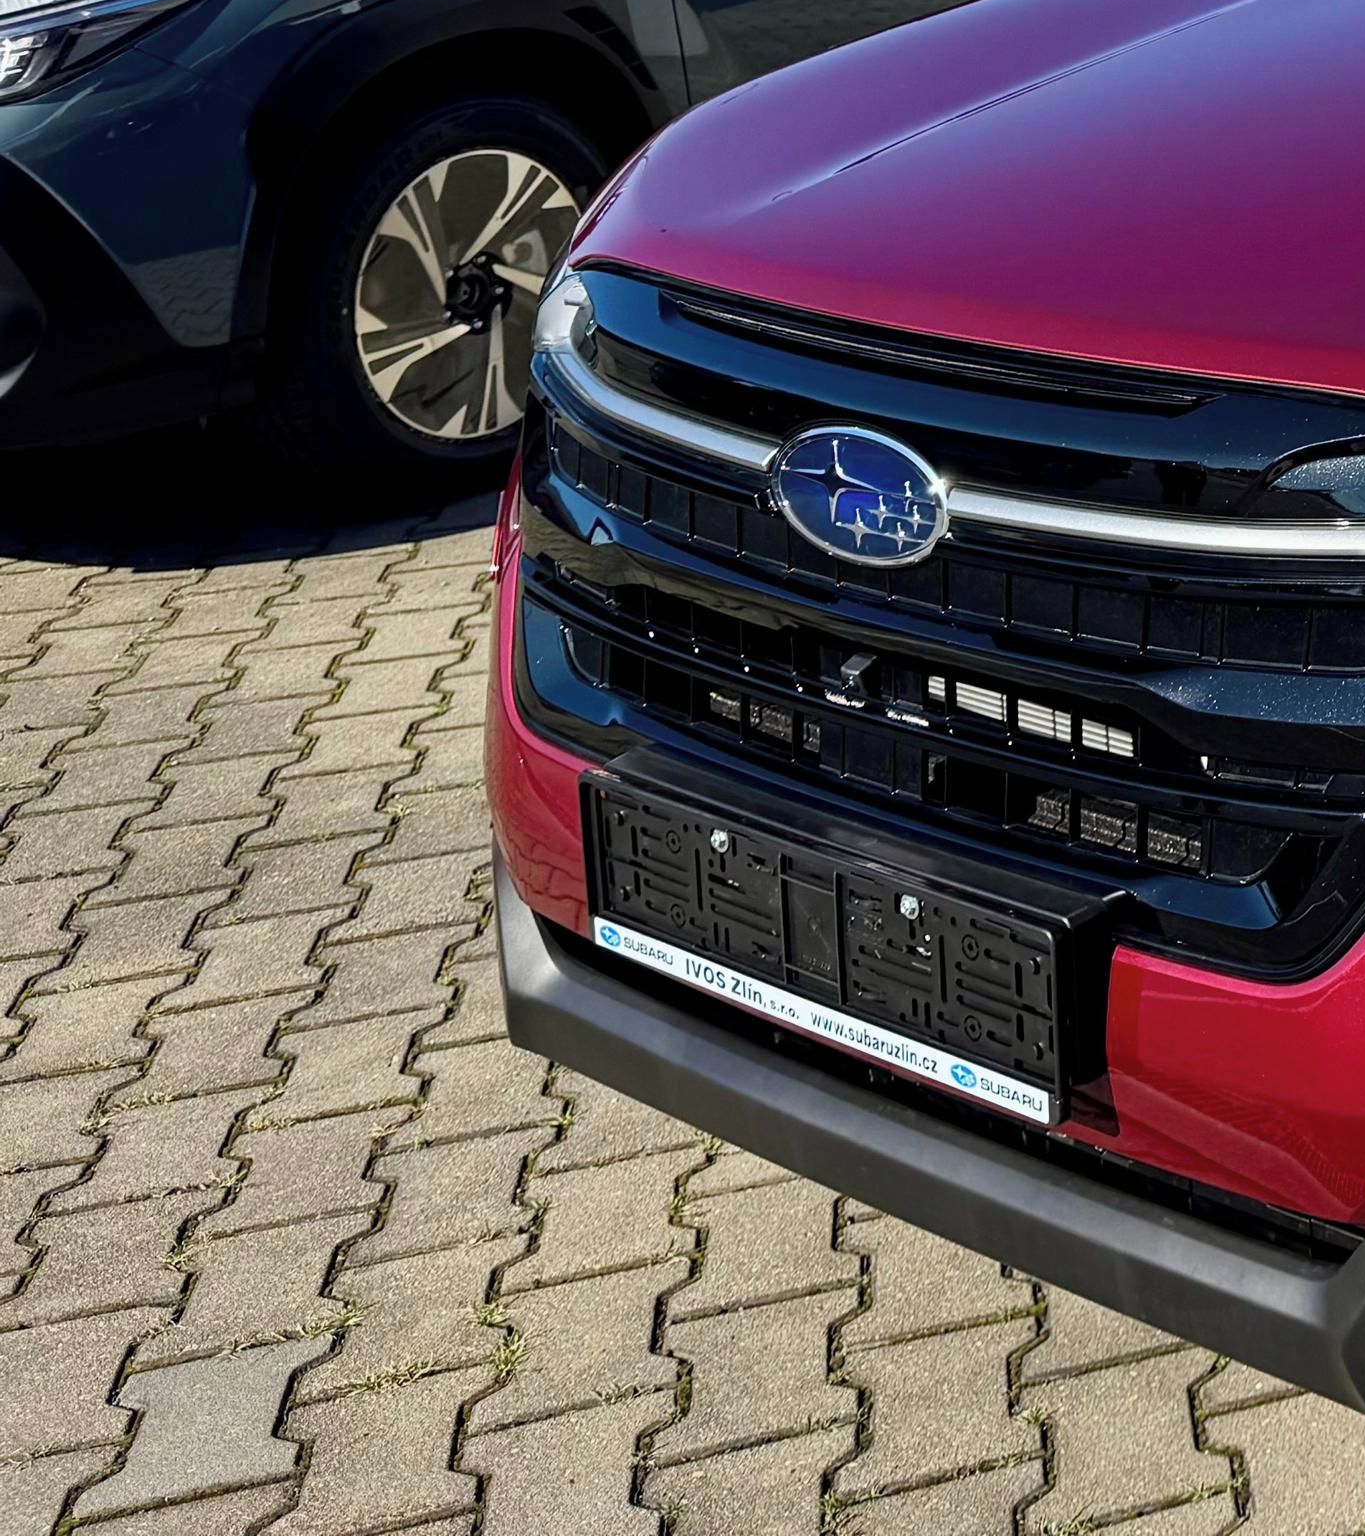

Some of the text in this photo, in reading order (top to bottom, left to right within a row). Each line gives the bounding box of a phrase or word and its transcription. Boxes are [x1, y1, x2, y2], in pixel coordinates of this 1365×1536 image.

[623, 936, 674, 966] SUBARU
[685, 957, 726, 990] IVOS
[769, 998, 800, 1020] s.r.o.
[809, 1011, 939, 1074] www.subaruzlin.cz
[979, 1077, 1044, 1113] SUBARU
